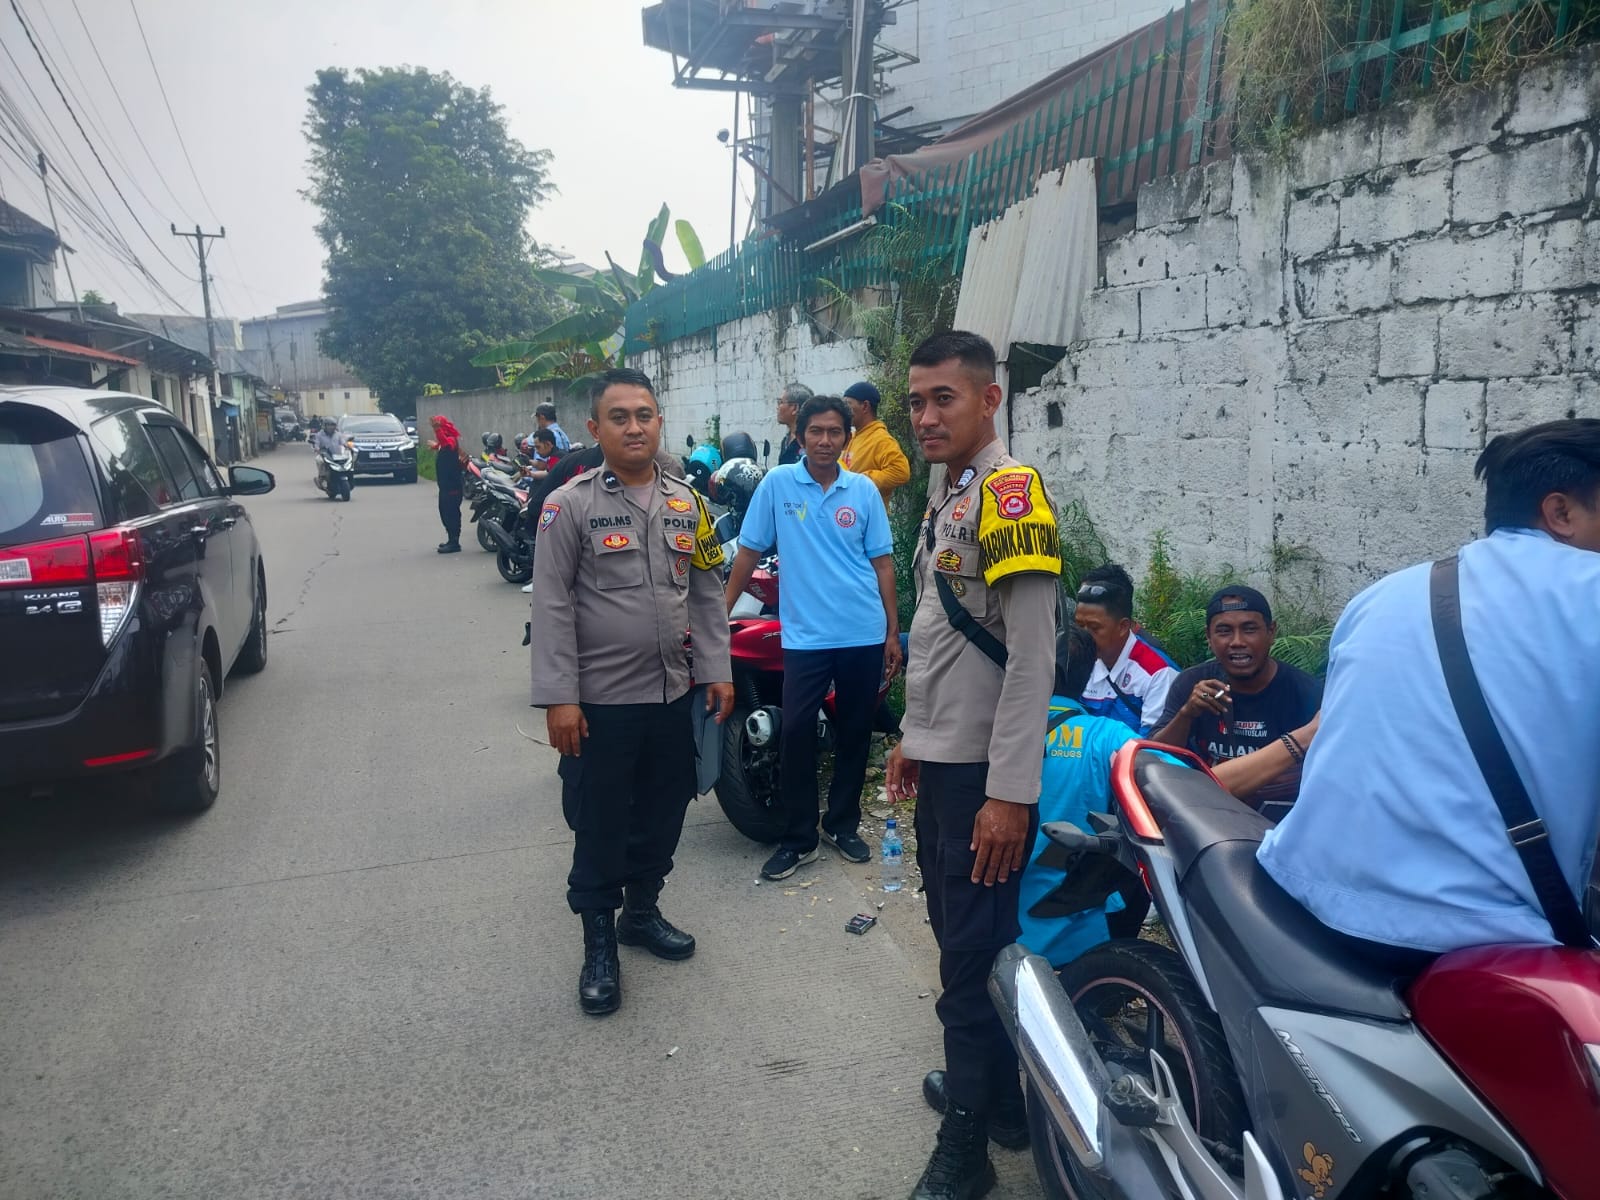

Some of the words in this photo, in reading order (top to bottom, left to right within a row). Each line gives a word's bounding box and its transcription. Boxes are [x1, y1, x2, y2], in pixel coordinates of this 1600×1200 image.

[589, 515, 632, 529] DIDI.MS
[663, 517, 697, 531] POLRI
[1051, 749, 1082, 758] DRUGS
